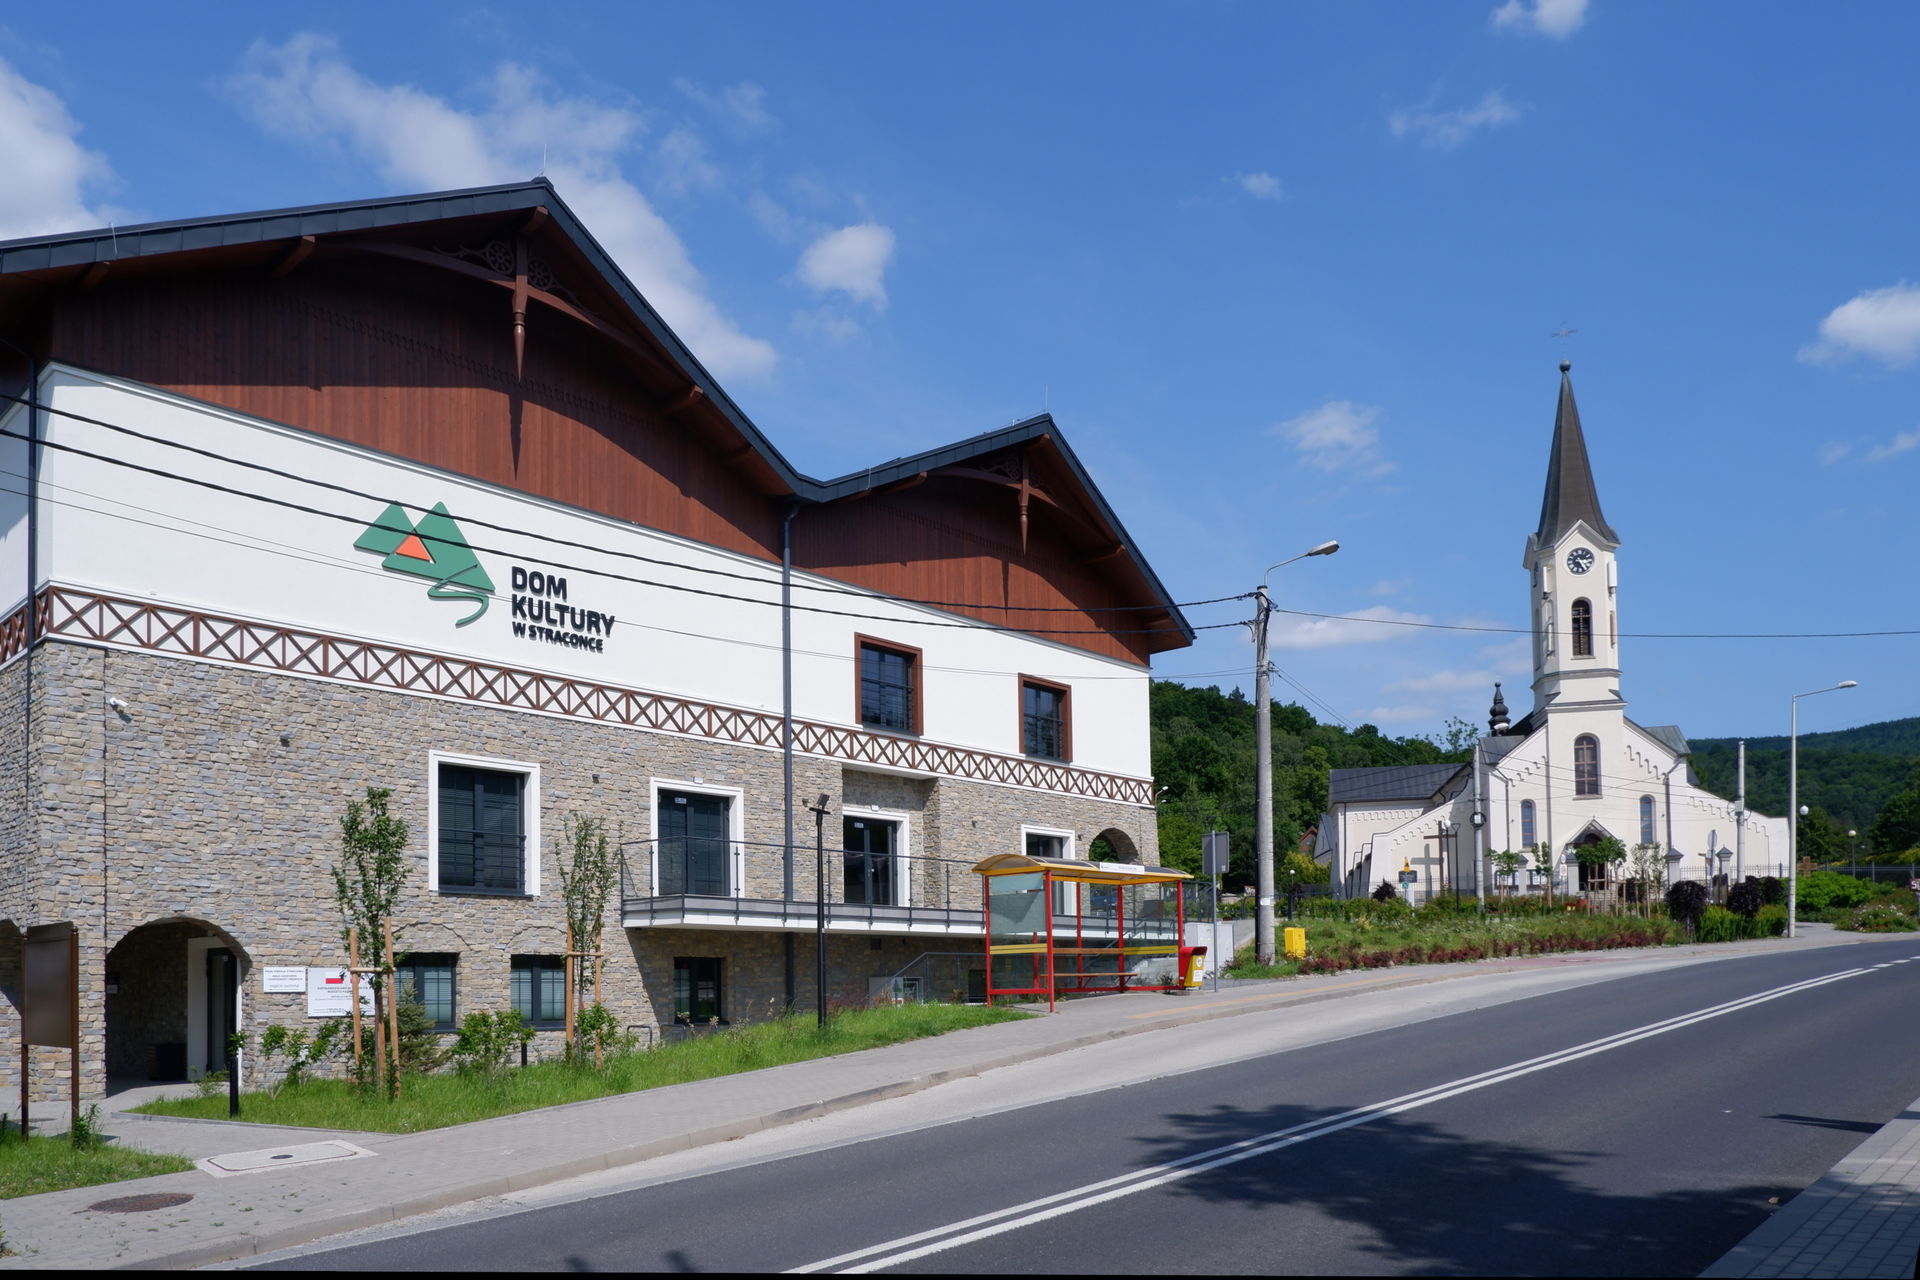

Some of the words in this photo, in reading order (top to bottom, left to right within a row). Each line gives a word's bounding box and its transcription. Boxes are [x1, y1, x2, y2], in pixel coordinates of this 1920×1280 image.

[511, 566, 567, 601] DOM
[511, 594, 615, 636] KULTURY
[512, 621, 526, 637] W
[528, 624, 603, 653] STRACONCE
